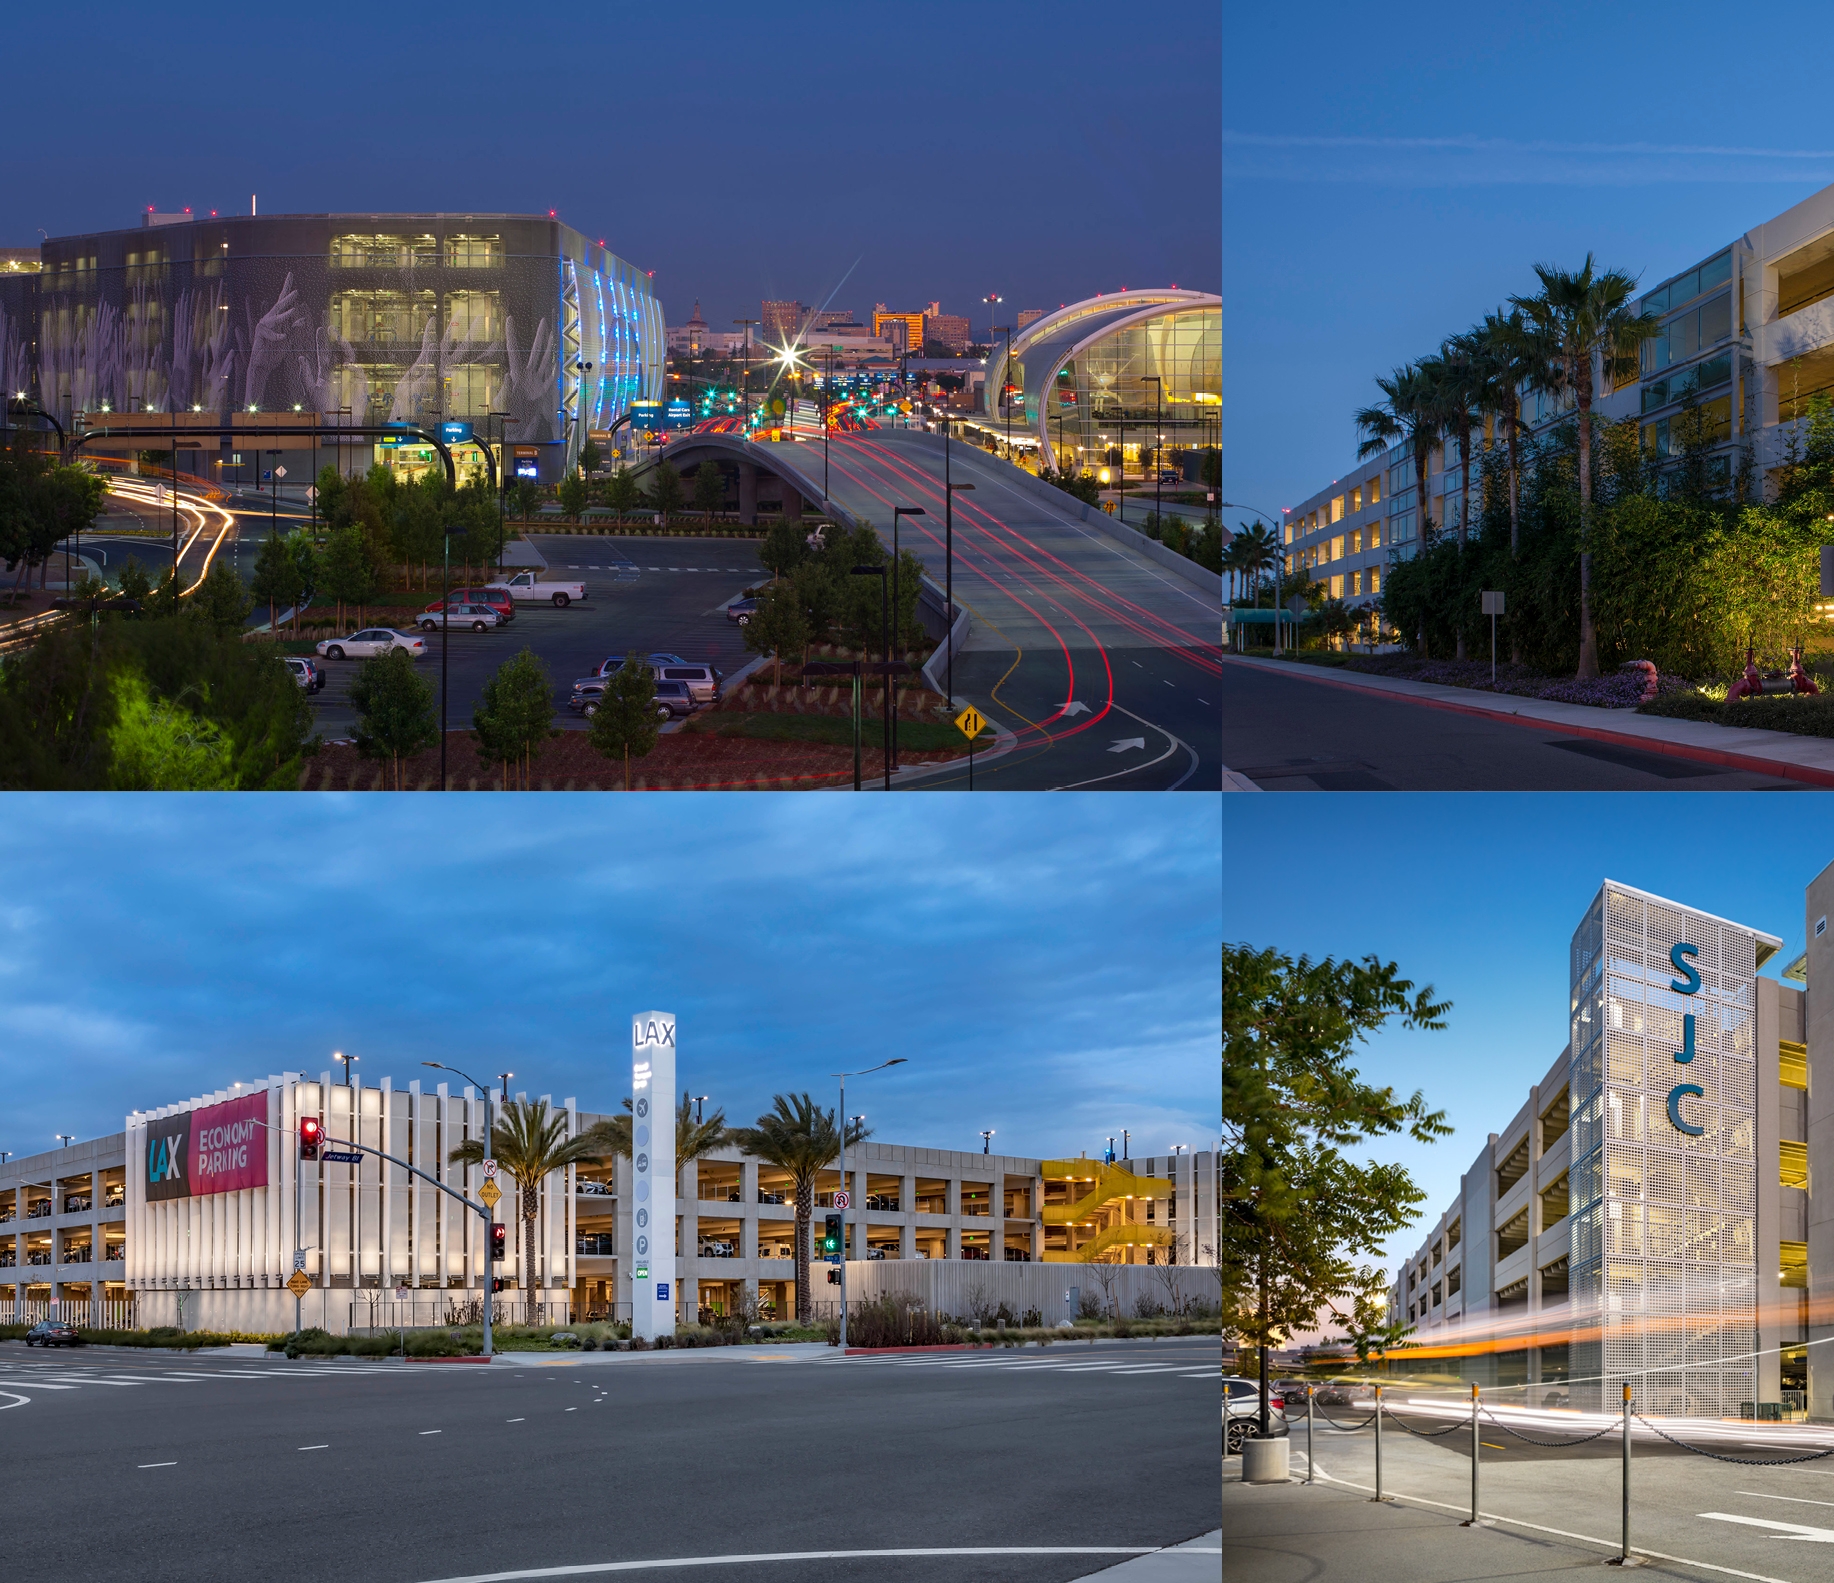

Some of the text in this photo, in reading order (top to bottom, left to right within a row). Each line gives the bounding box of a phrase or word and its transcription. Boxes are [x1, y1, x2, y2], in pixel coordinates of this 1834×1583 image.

[635, 1021, 675, 1048] LAX
[1667, 942, 1704, 1136] SJC
[199, 1120, 257, 1152] ECONOMY
[149, 1134, 182, 1182] LAX
[198, 1144, 247, 1176] PARKING
